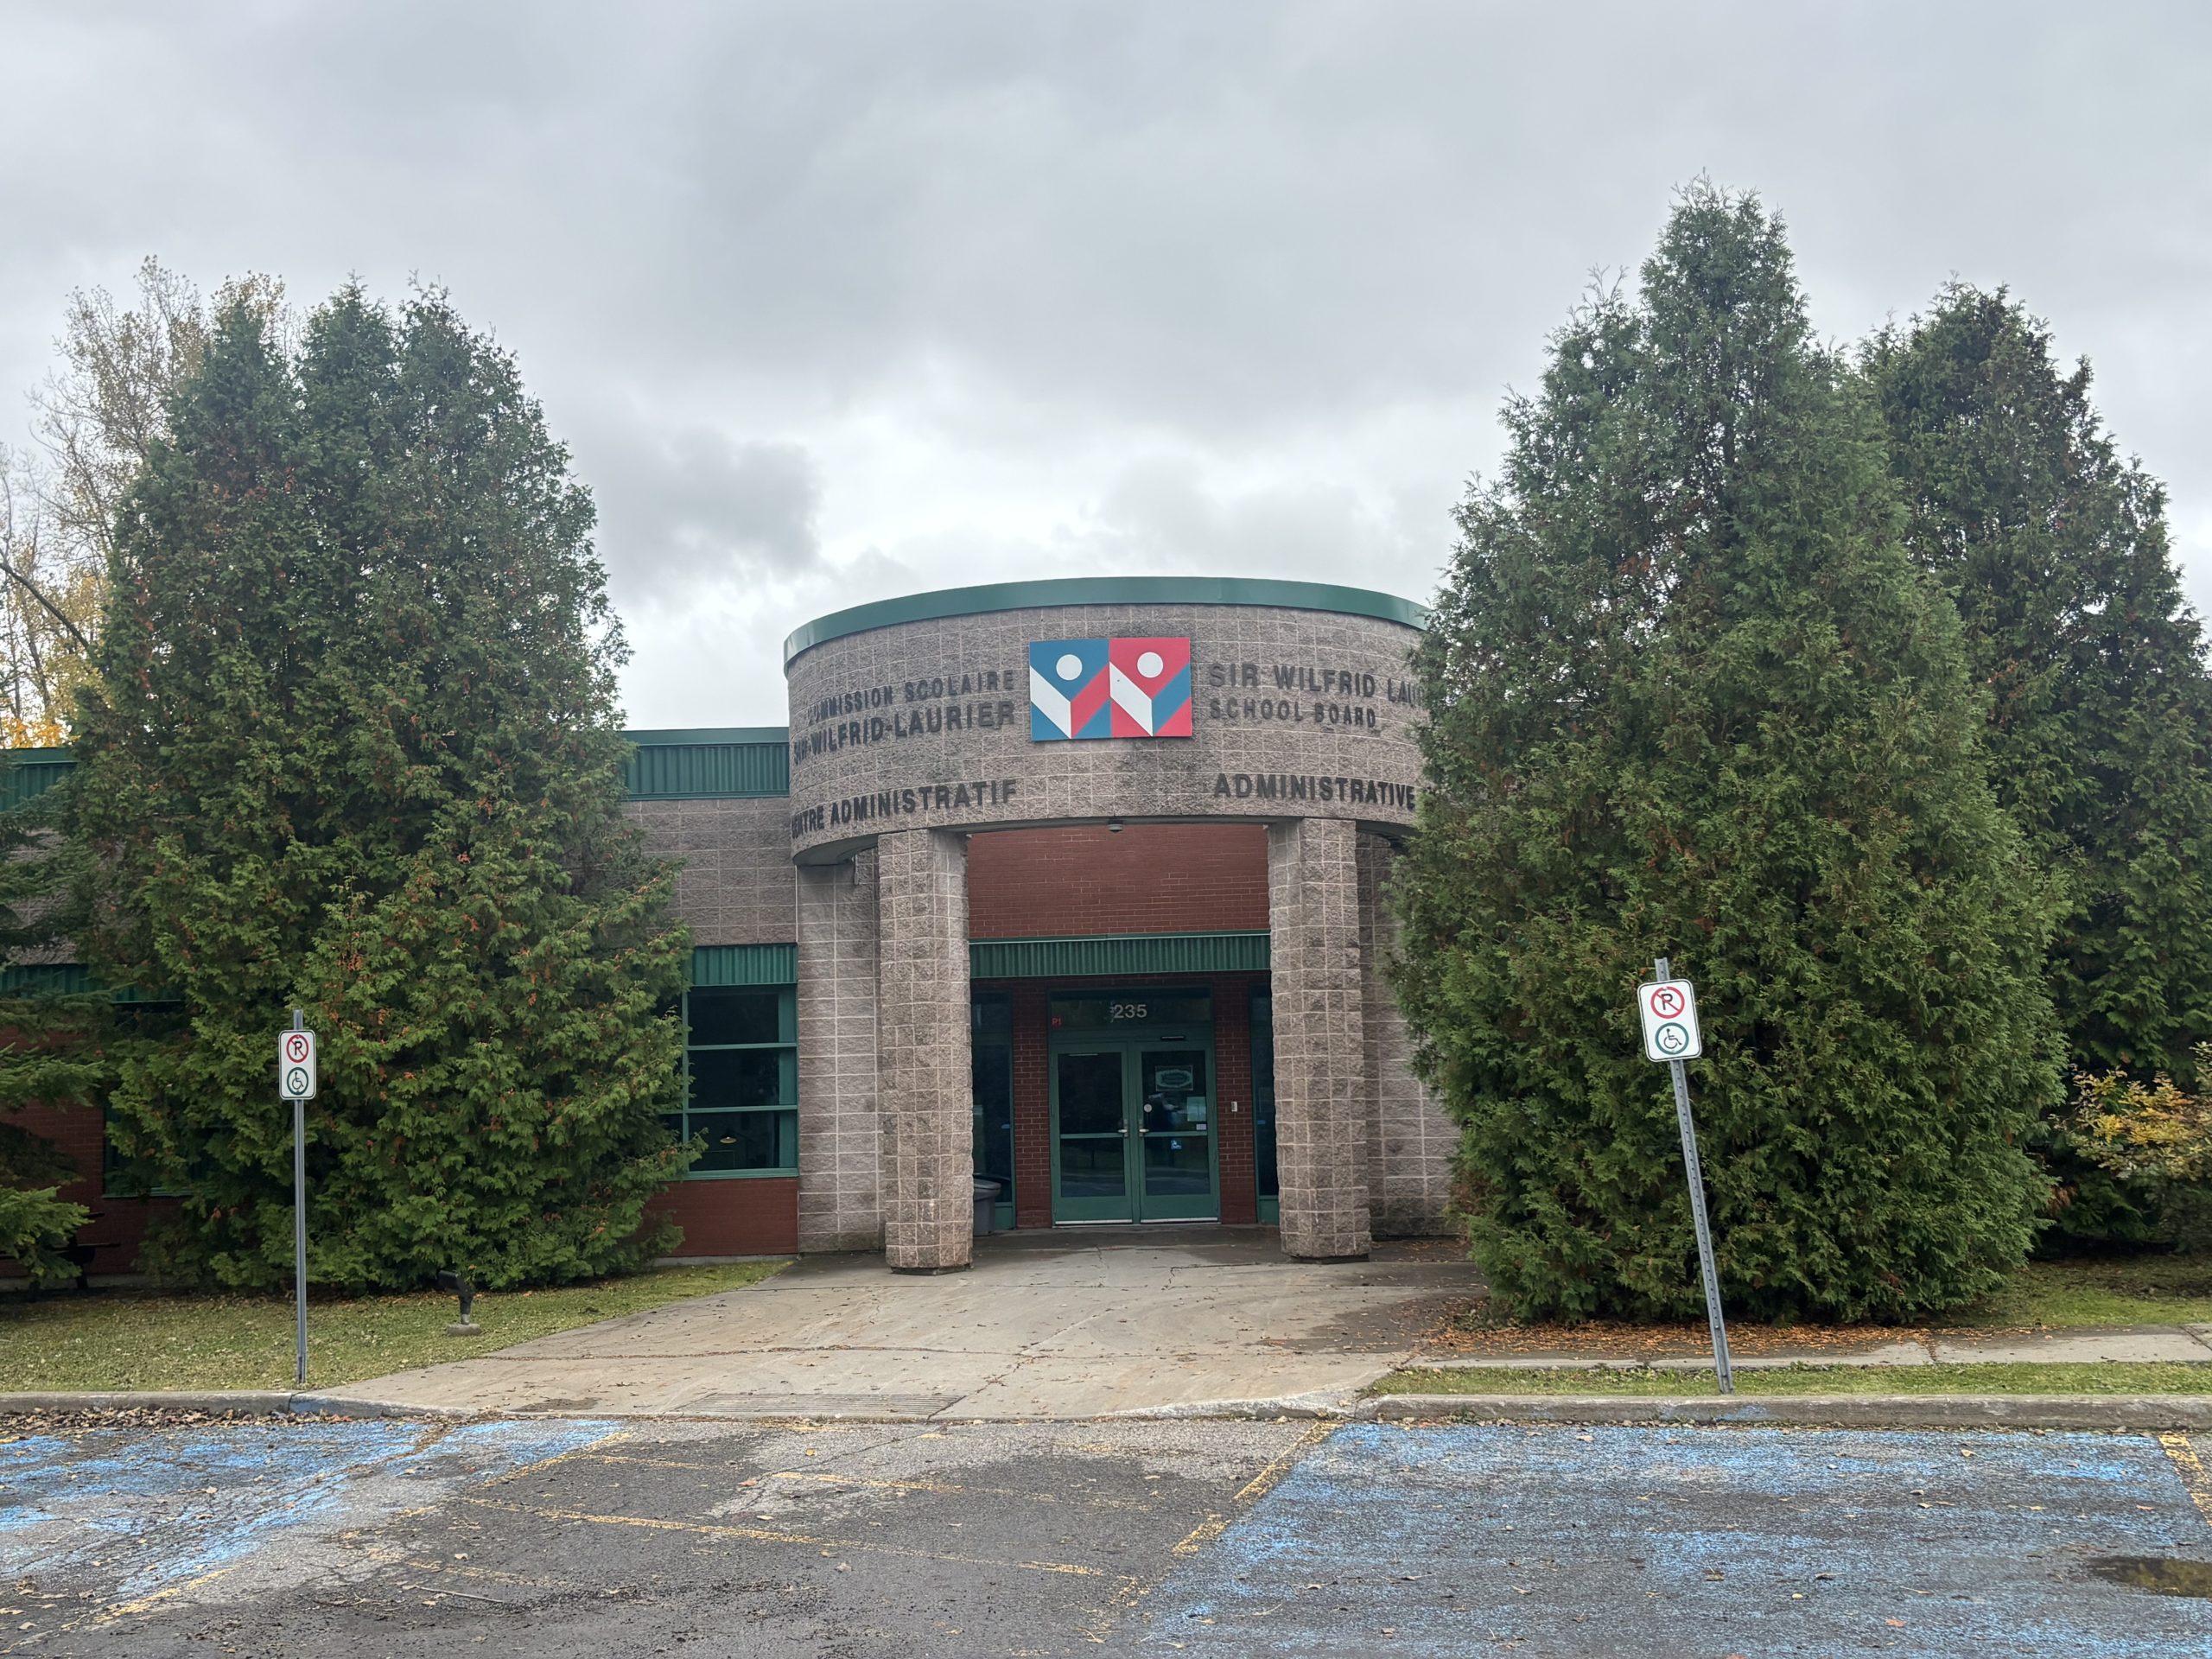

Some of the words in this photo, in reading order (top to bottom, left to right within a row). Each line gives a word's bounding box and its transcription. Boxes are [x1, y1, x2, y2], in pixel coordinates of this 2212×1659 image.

[906, 671, 1014, 702] SCOLAIRE
[1209, 663, 1259, 687] SIR
[1274, 664, 1376, 697] WILFRID
[1210, 698, 1303, 721] SCHOOL
[1314, 702, 1376, 728] BOARD
[830, 779, 1017, 824] ADMINISTRATIF
[1214, 772, 1416, 810] ADMINISTRATIVE
[1114, 1004, 1147, 1018] 235
